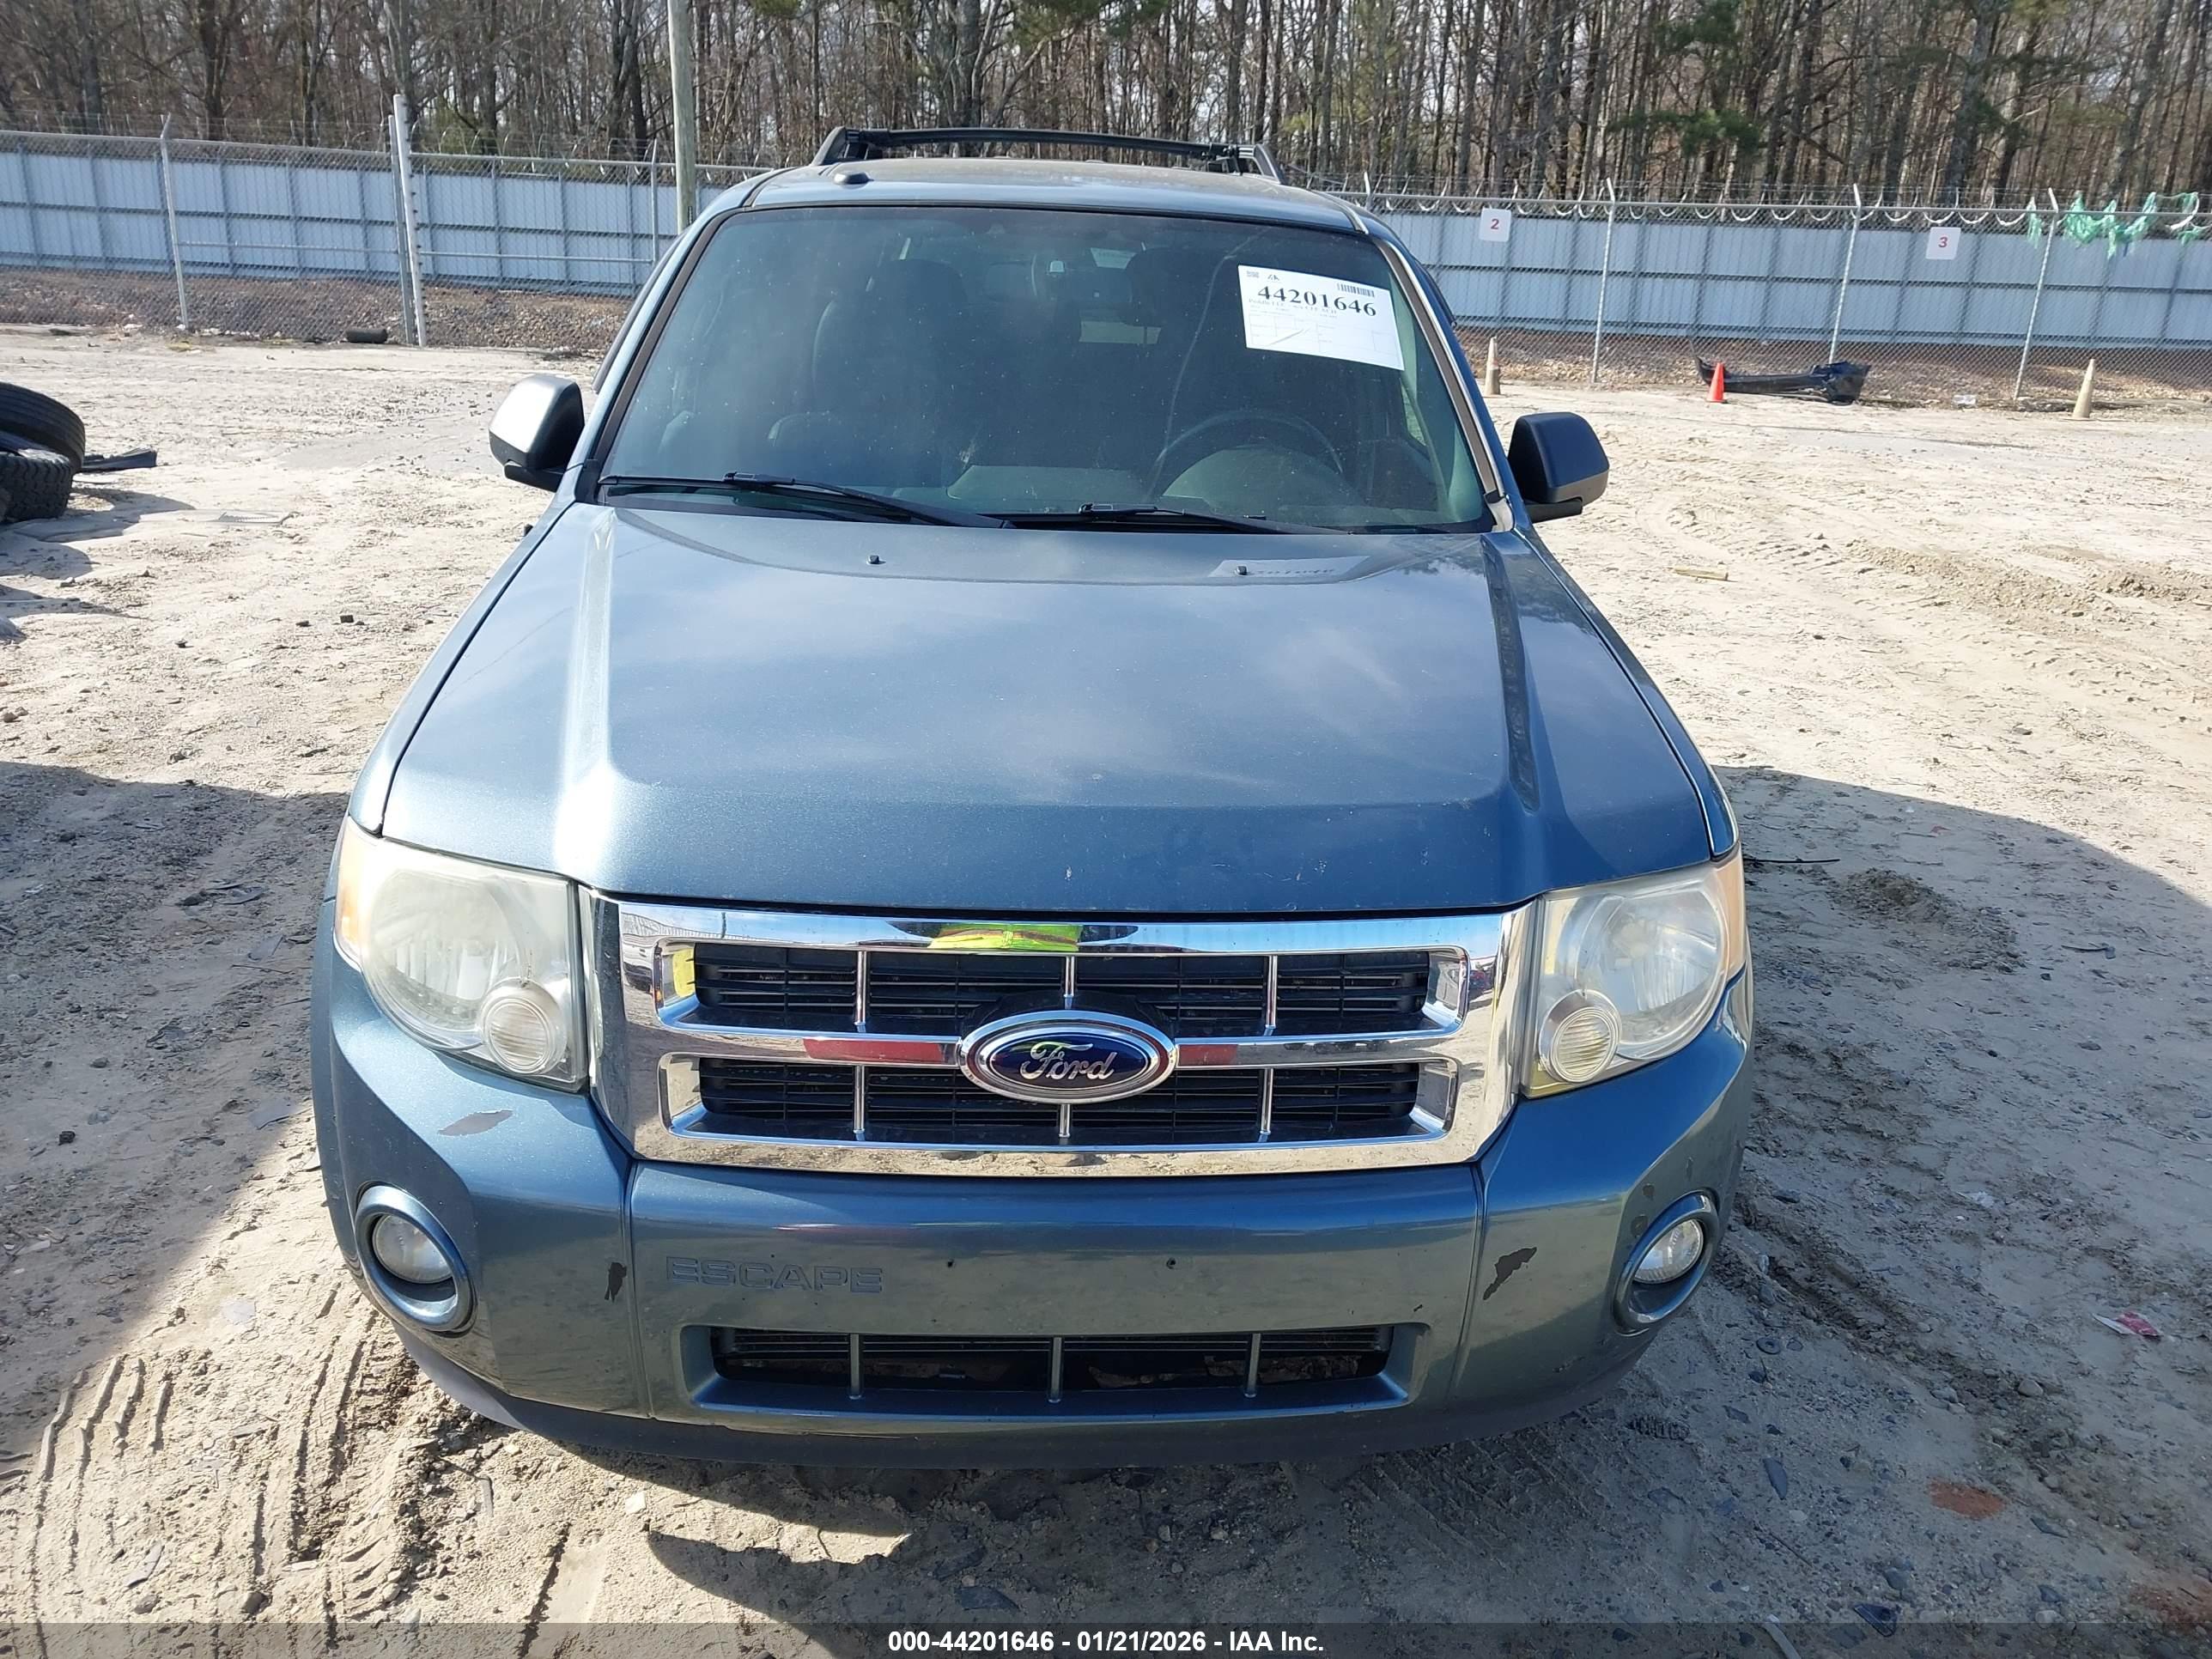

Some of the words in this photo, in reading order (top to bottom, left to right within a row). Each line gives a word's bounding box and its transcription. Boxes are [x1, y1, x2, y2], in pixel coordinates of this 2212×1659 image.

[1490, 218, 1499, 230] 2
[1938, 236, 1948, 248] 3
[1257, 285, 1377, 317] 44201646
[1019, 1041, 1118, 1080] Ford
[665, 1255, 884, 1293] ESCAPE
